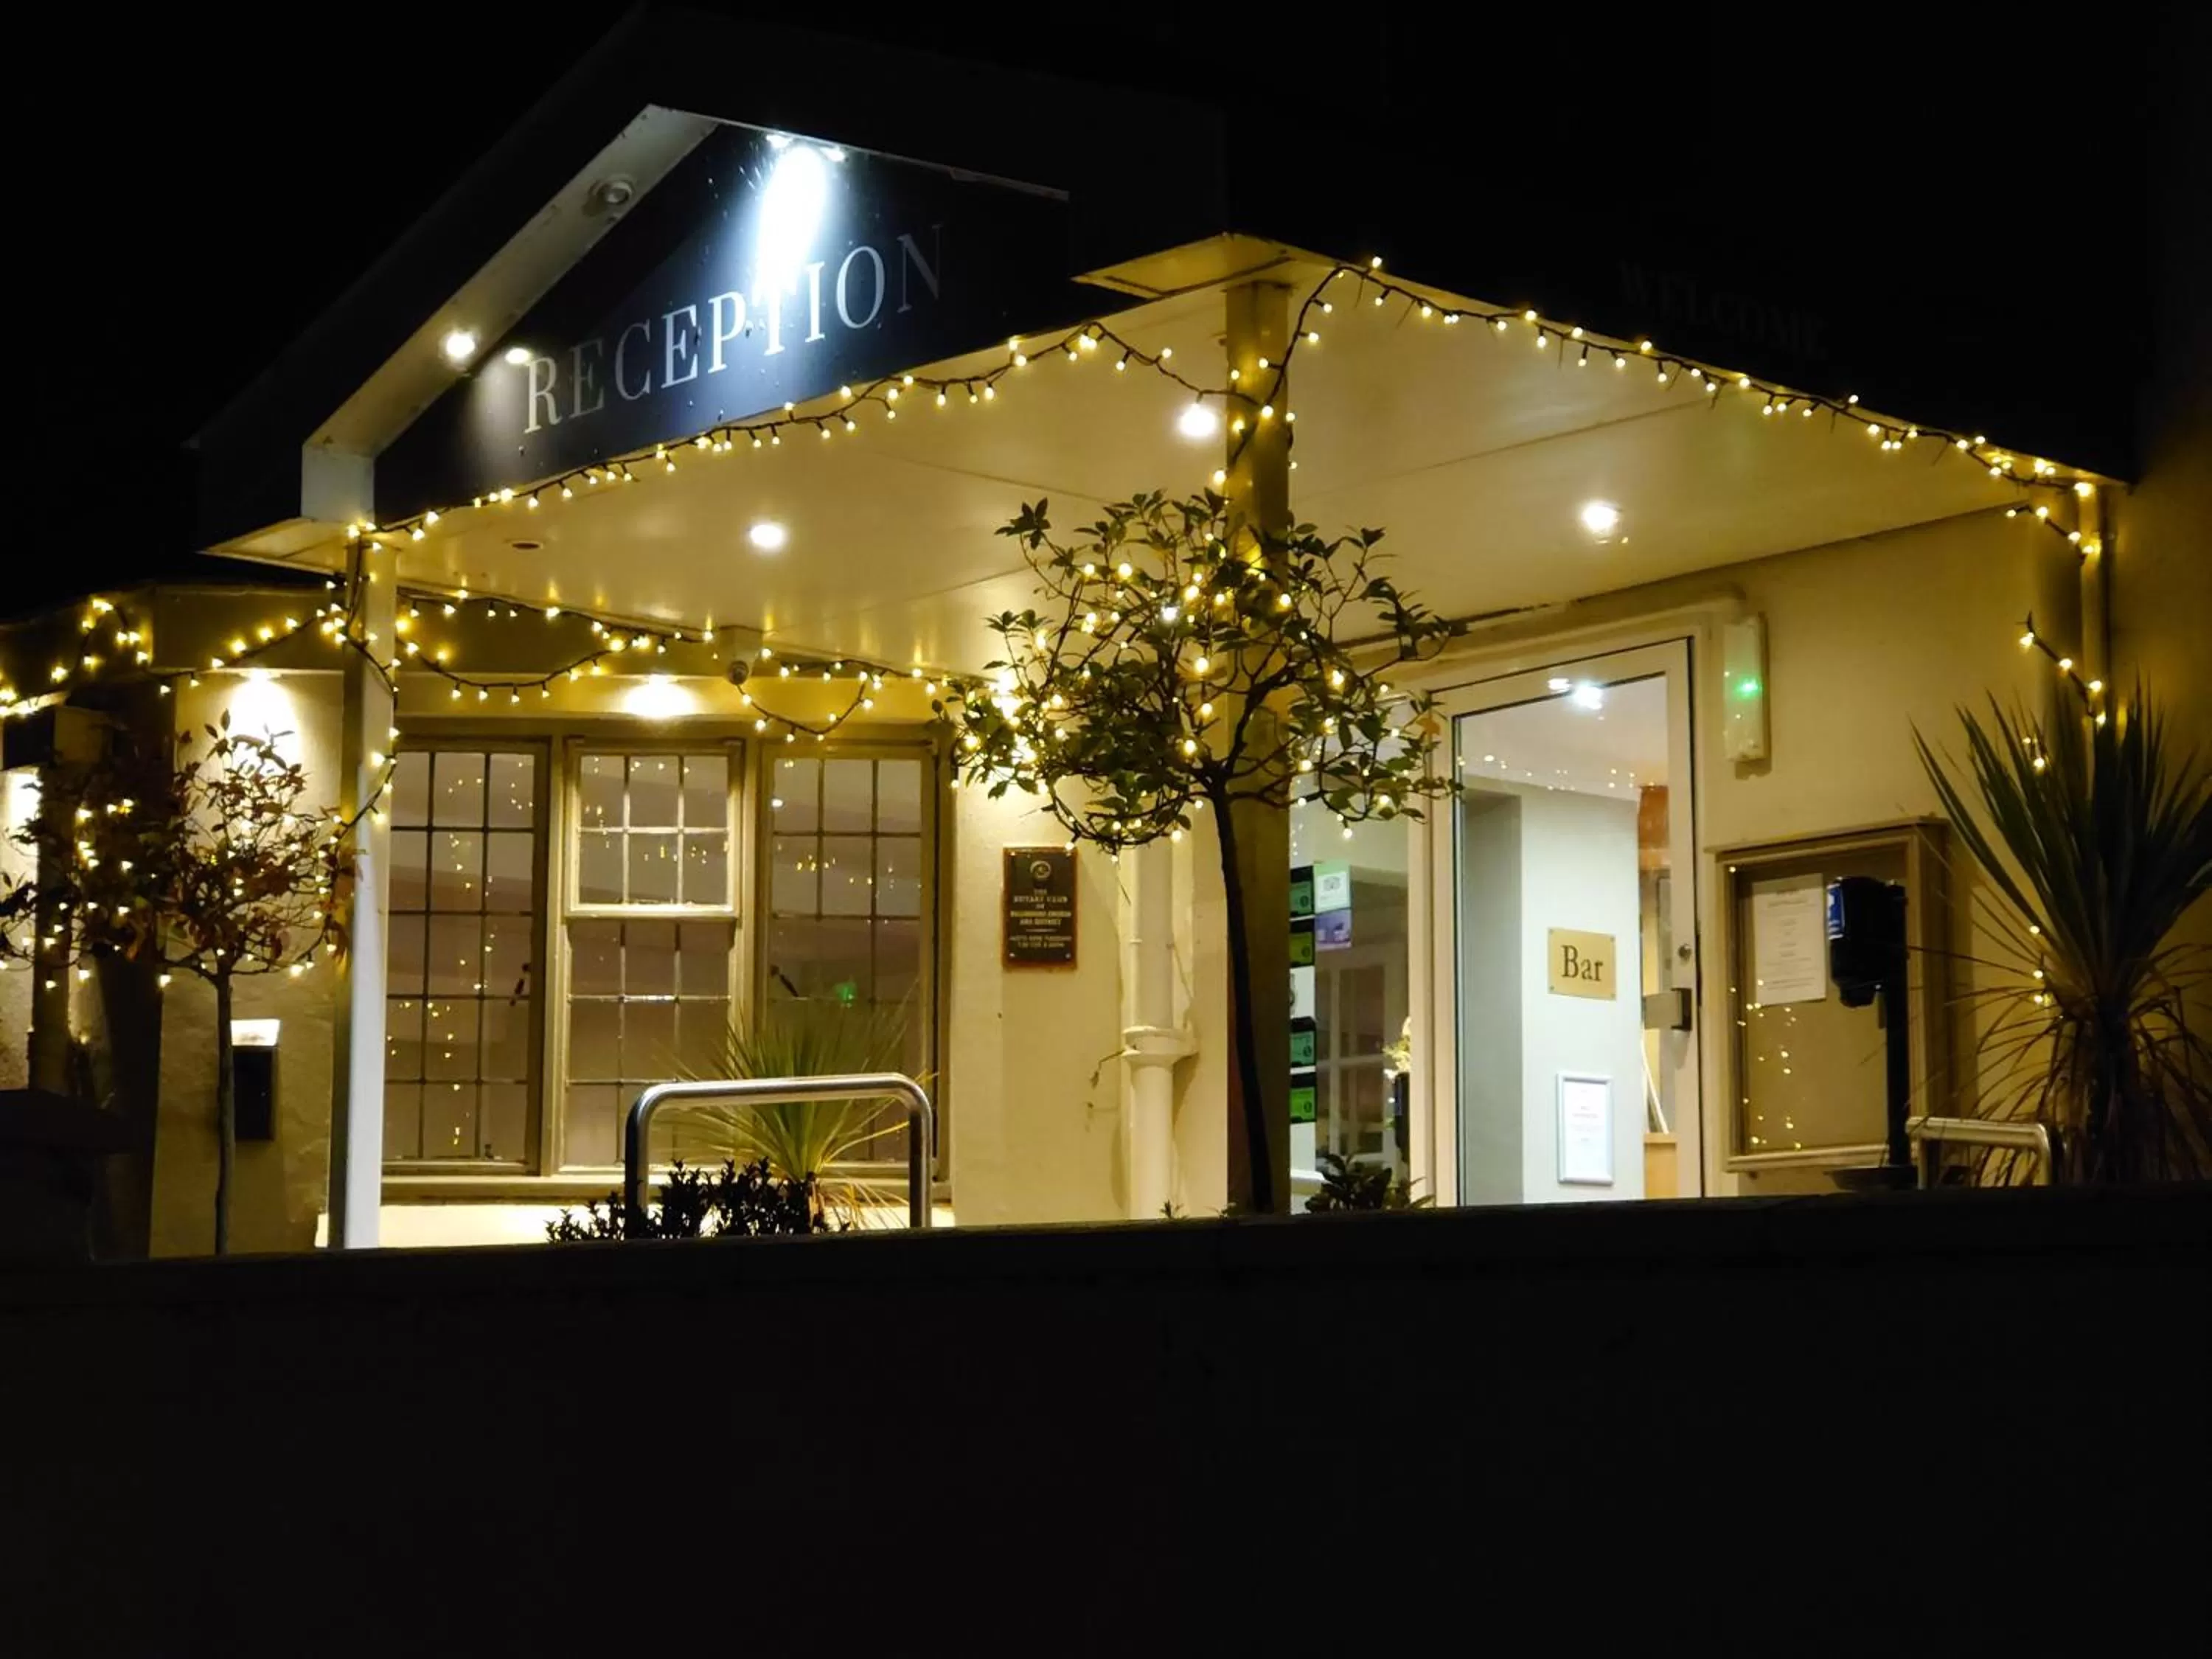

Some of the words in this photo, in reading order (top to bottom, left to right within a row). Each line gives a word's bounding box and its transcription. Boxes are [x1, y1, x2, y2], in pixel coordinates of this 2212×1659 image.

[524, 223, 945, 434] RECEPTION
[1616, 258, 1829, 362] WELCOME
[1560, 944, 1604, 981] Bar
